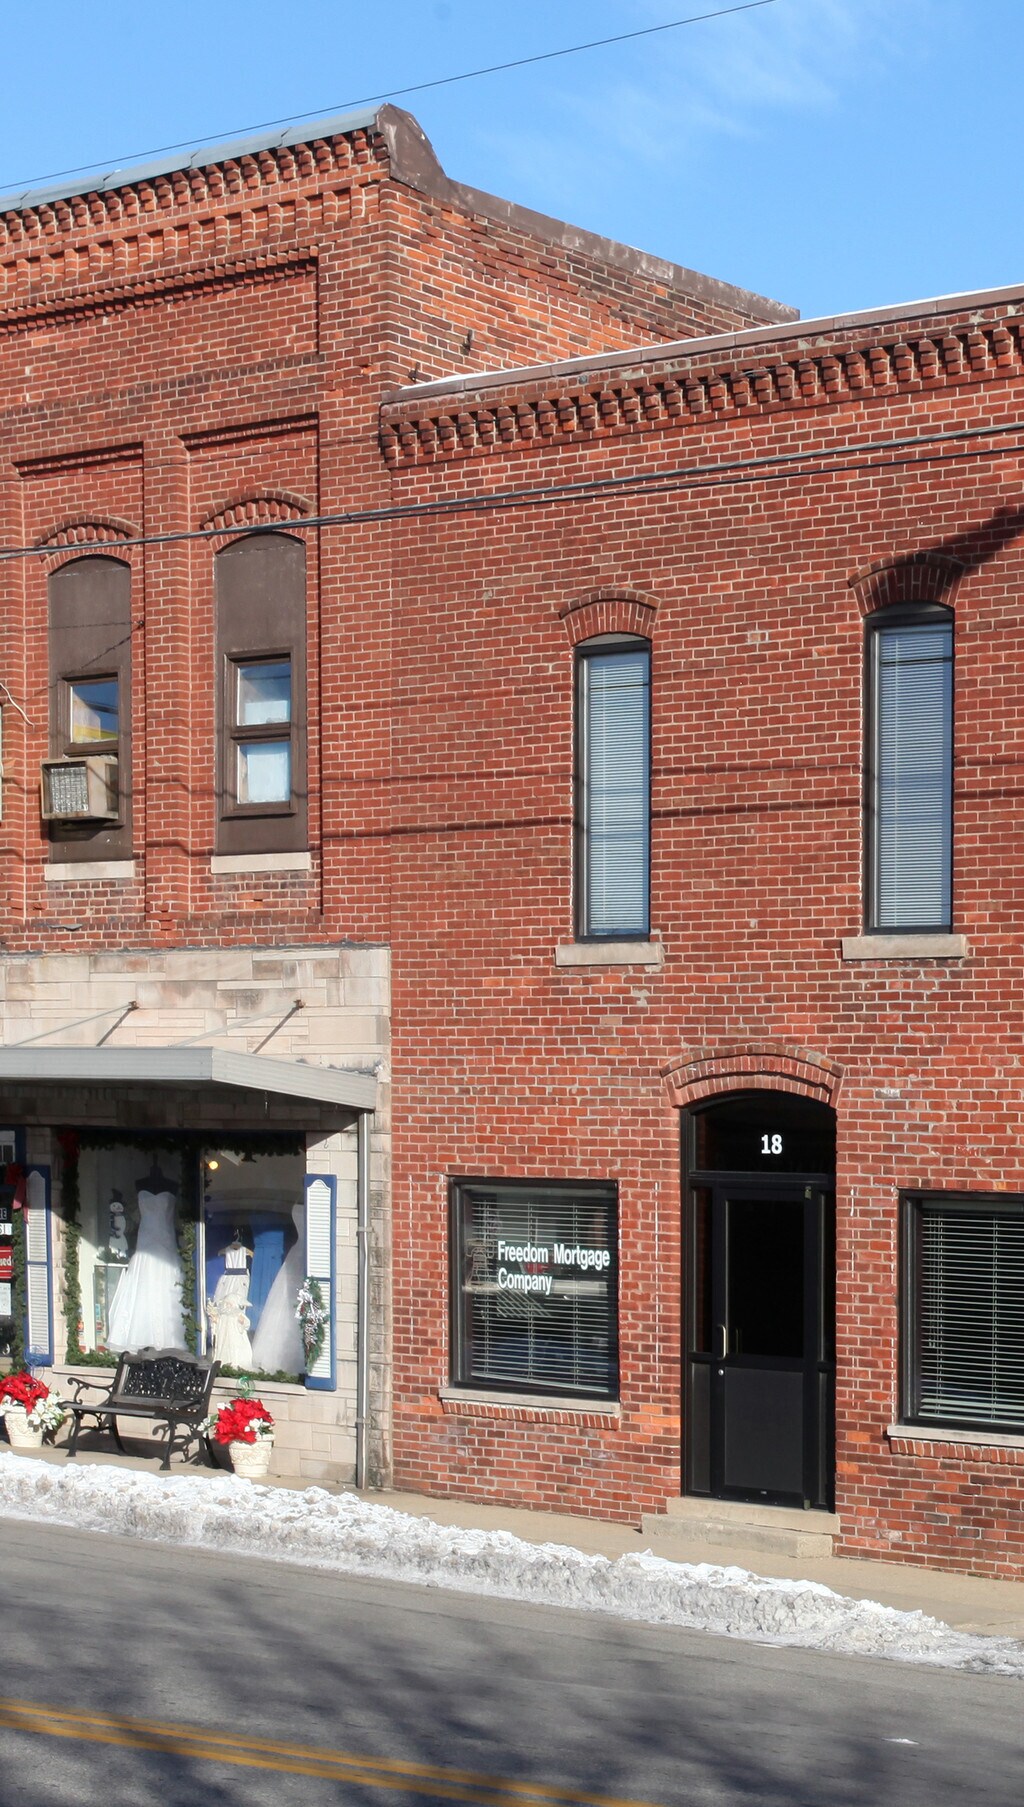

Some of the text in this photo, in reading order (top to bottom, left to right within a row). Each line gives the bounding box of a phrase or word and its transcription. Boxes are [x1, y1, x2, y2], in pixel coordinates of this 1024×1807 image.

[761, 1134, 782, 1154] 18
[498, 1241, 610, 1271] Freedom Mortgage
[498, 1267, 552, 1295] Company
